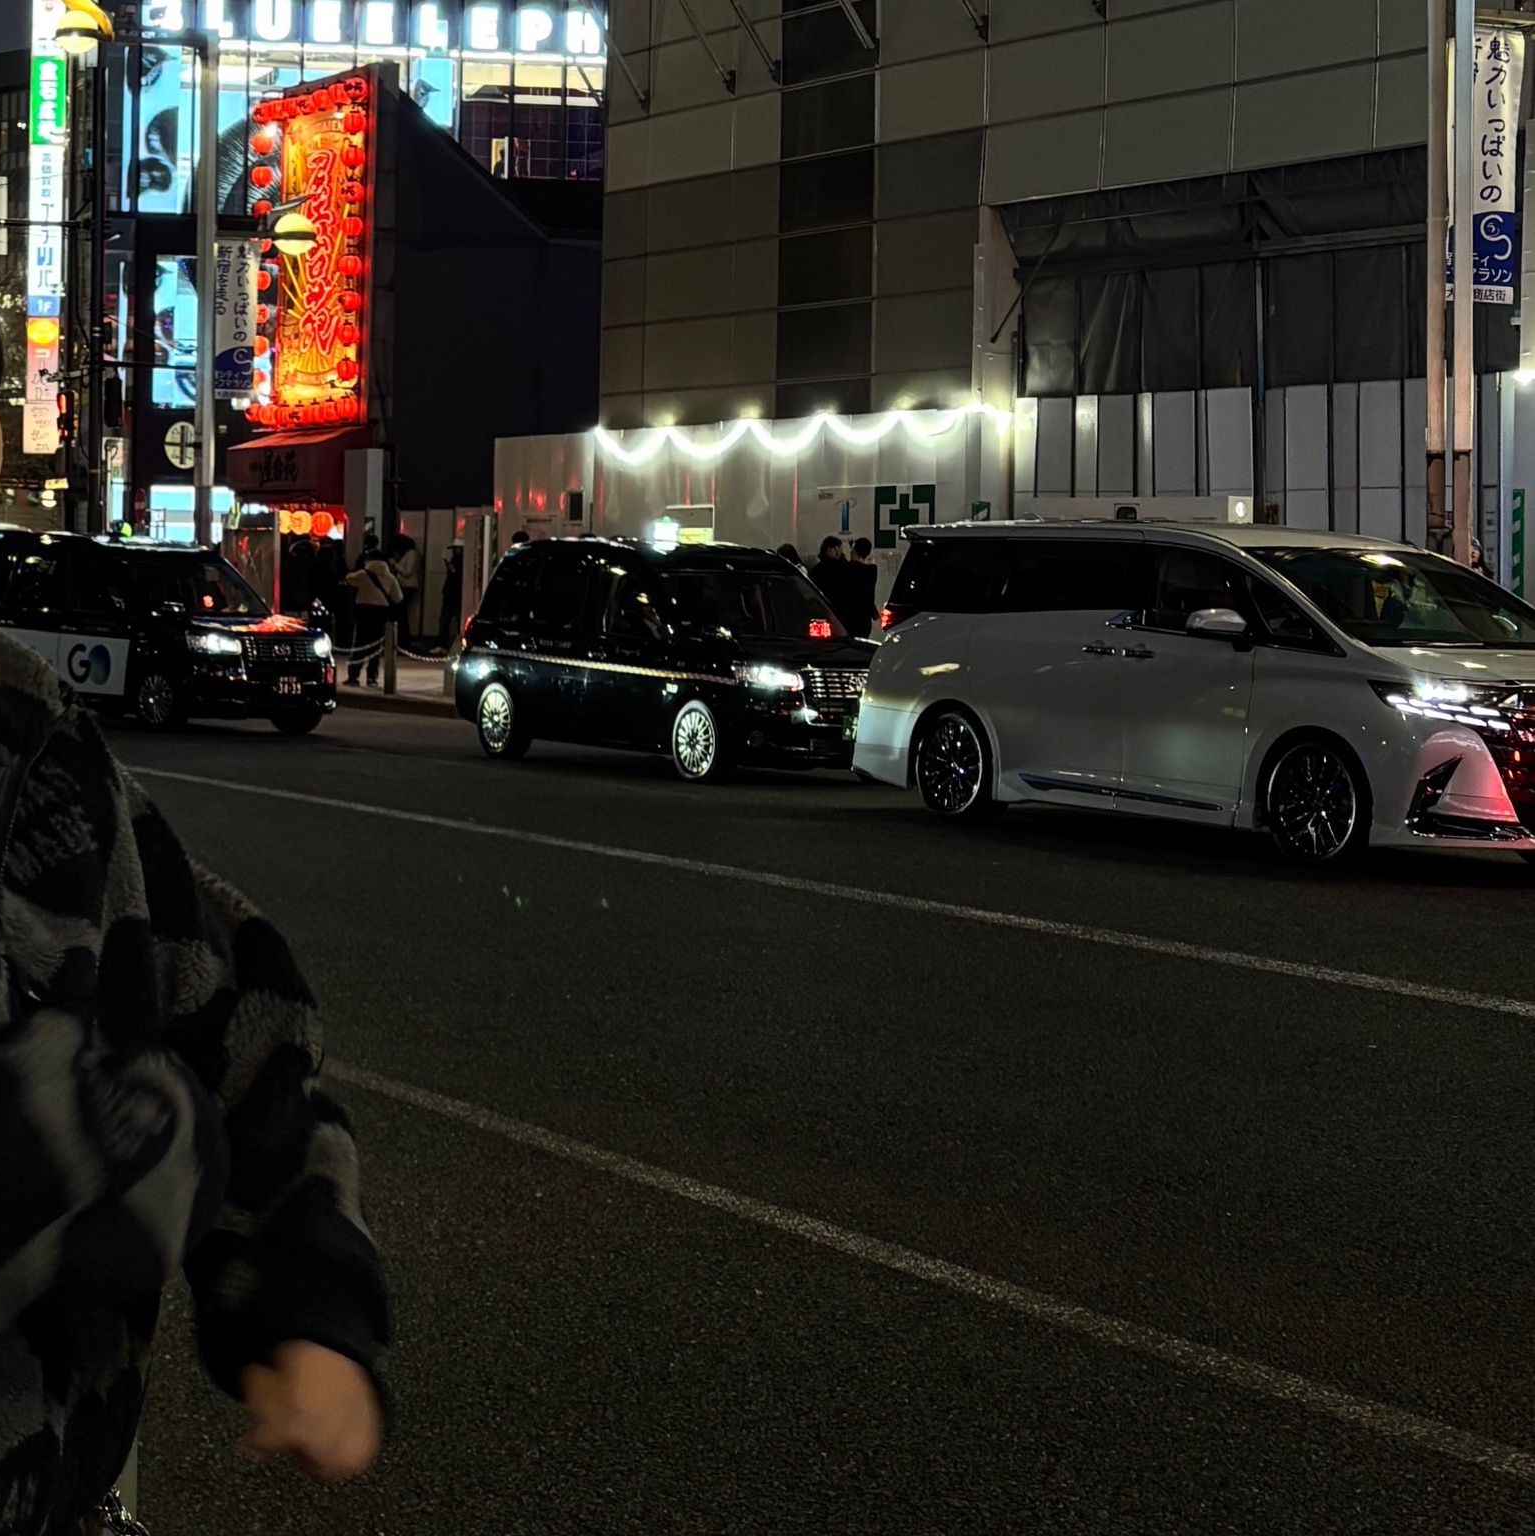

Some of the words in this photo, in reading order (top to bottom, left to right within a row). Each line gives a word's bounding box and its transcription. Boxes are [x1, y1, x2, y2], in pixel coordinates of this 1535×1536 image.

[1479, 36, 1512, 203] 魅力いっぱいの
[36, 299, 53, 313] 1F
[233, 244, 251, 343] 魅力いっぱいの
[67, 643, 111, 686] GO
